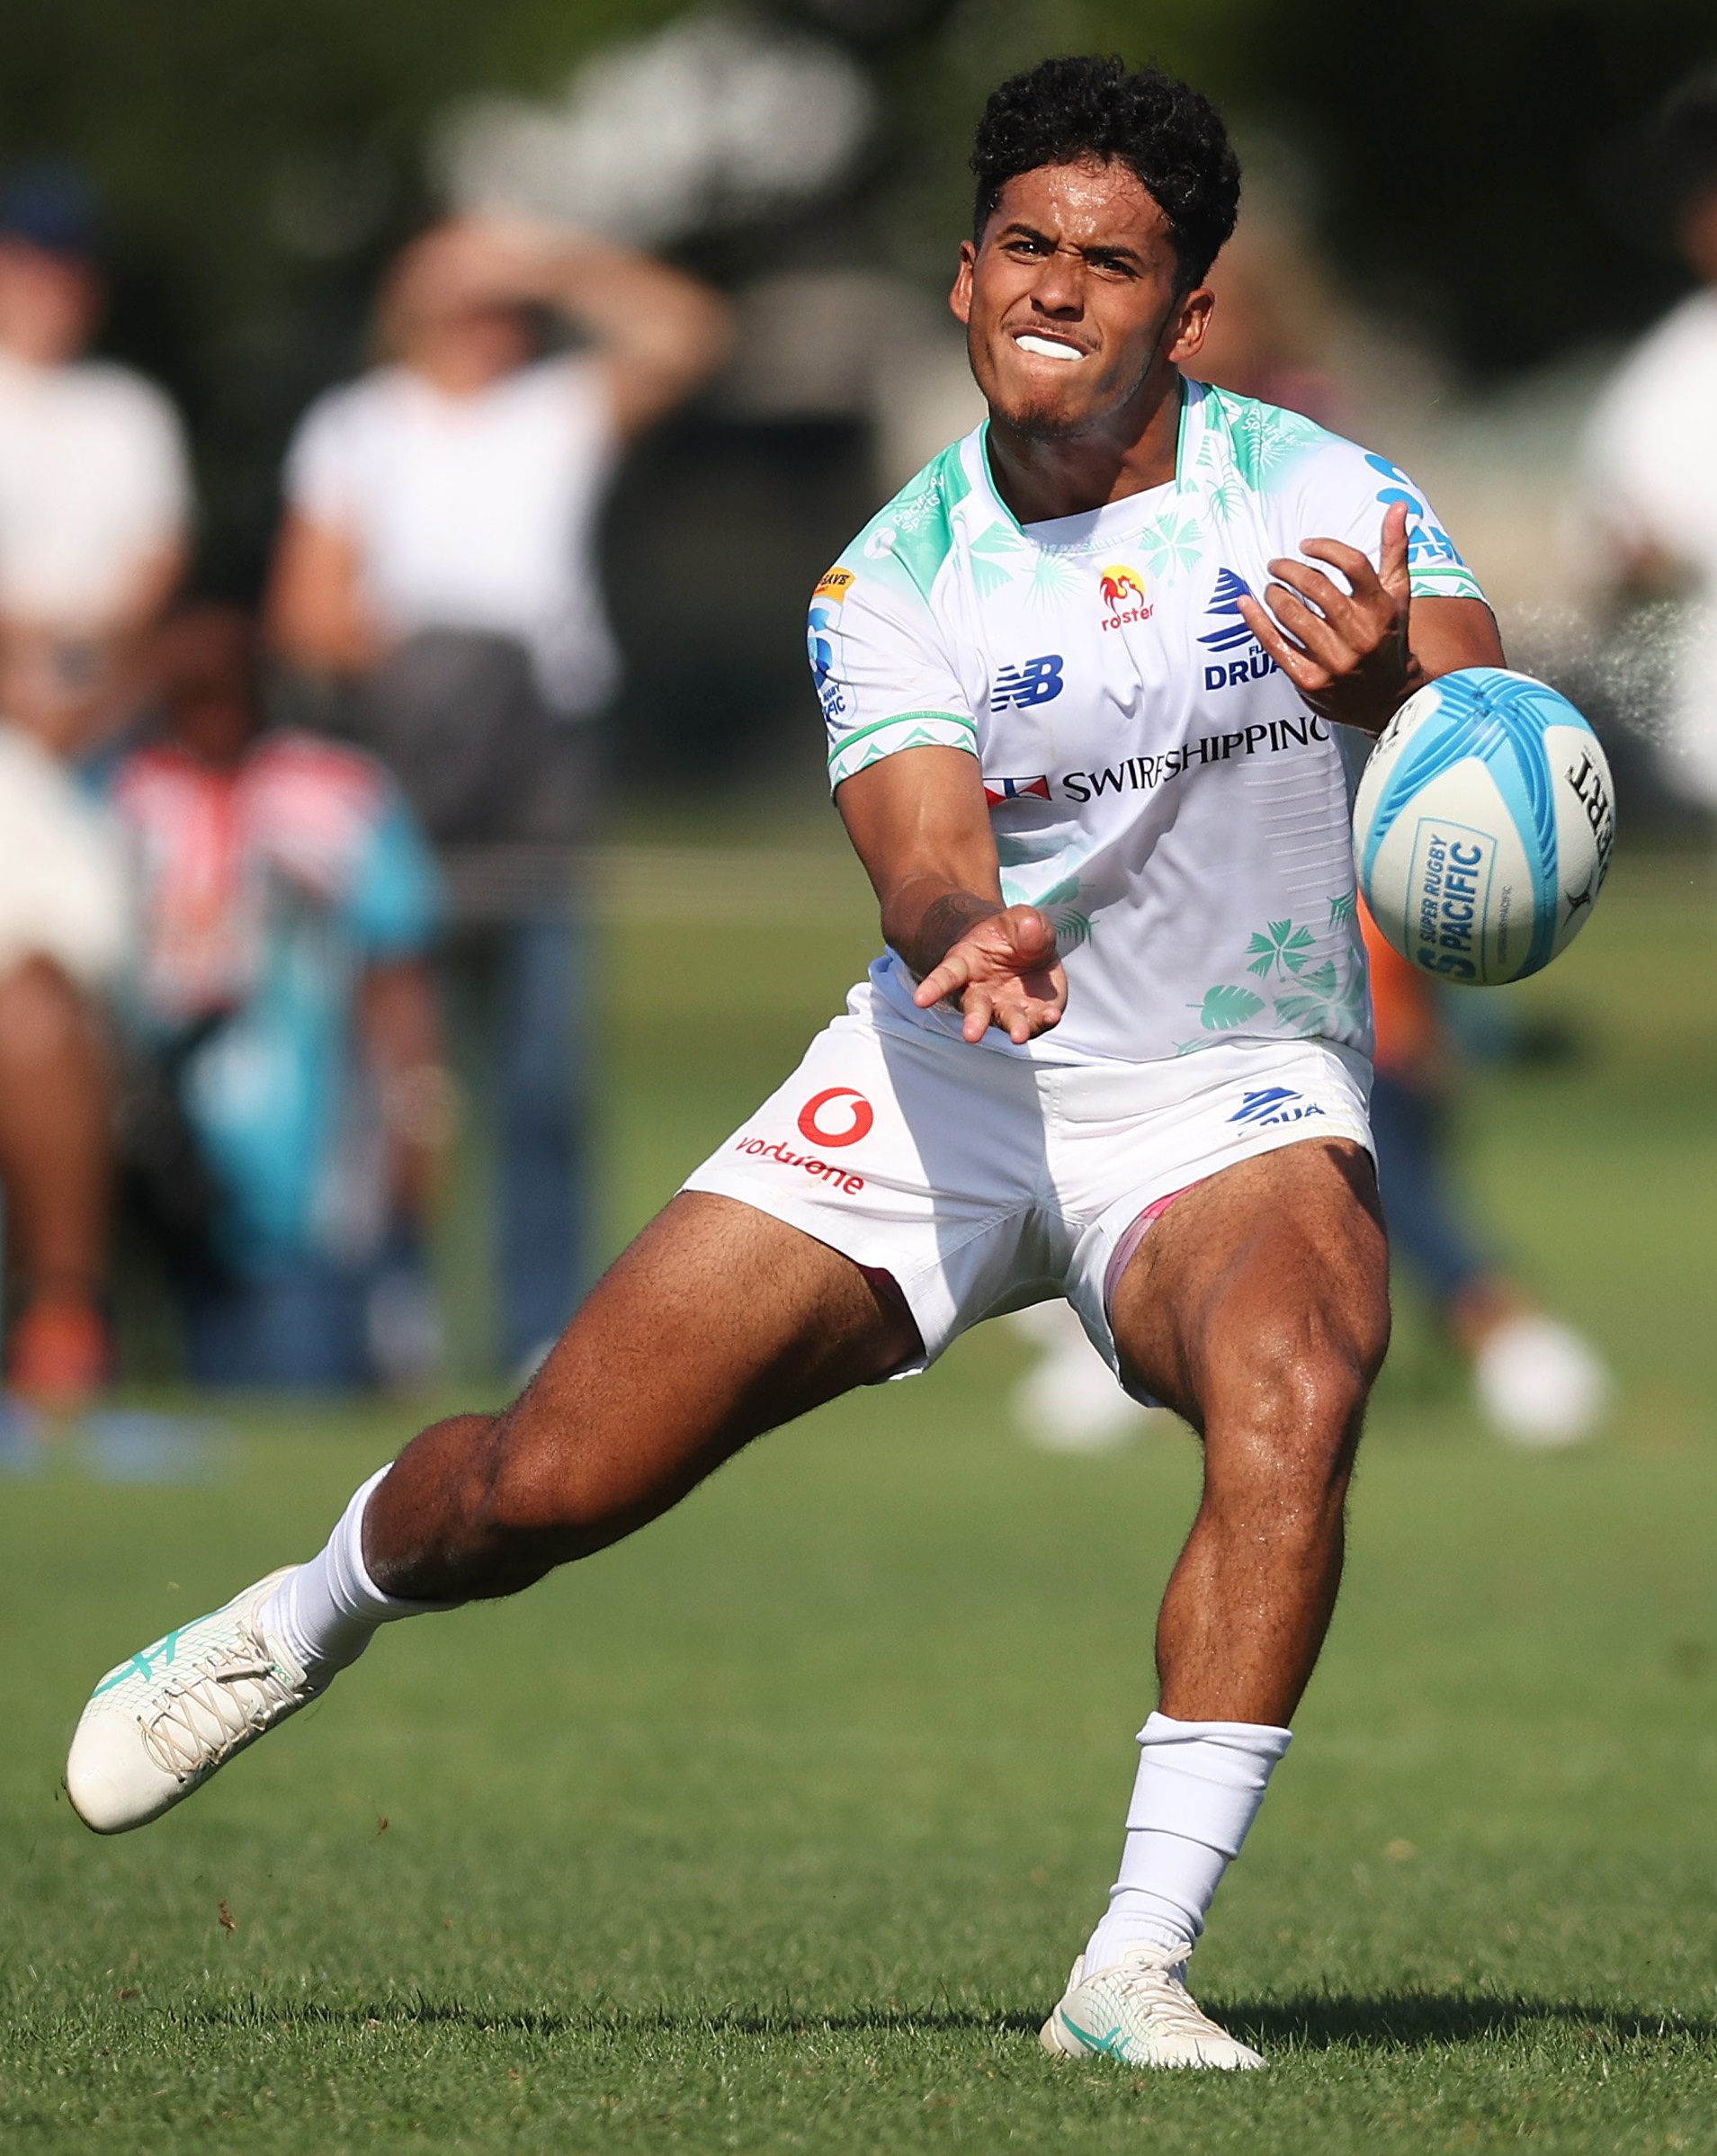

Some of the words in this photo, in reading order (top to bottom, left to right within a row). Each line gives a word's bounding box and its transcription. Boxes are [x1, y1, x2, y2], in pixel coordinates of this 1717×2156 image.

[1102, 604, 1153, 631] roster
[1248, 645, 1265, 657] FIJ
[1423, 833, 1448, 897] RUGBY
[1439, 841, 1482, 952] PACIFIC
[1420, 897, 1439, 944] SUPER
